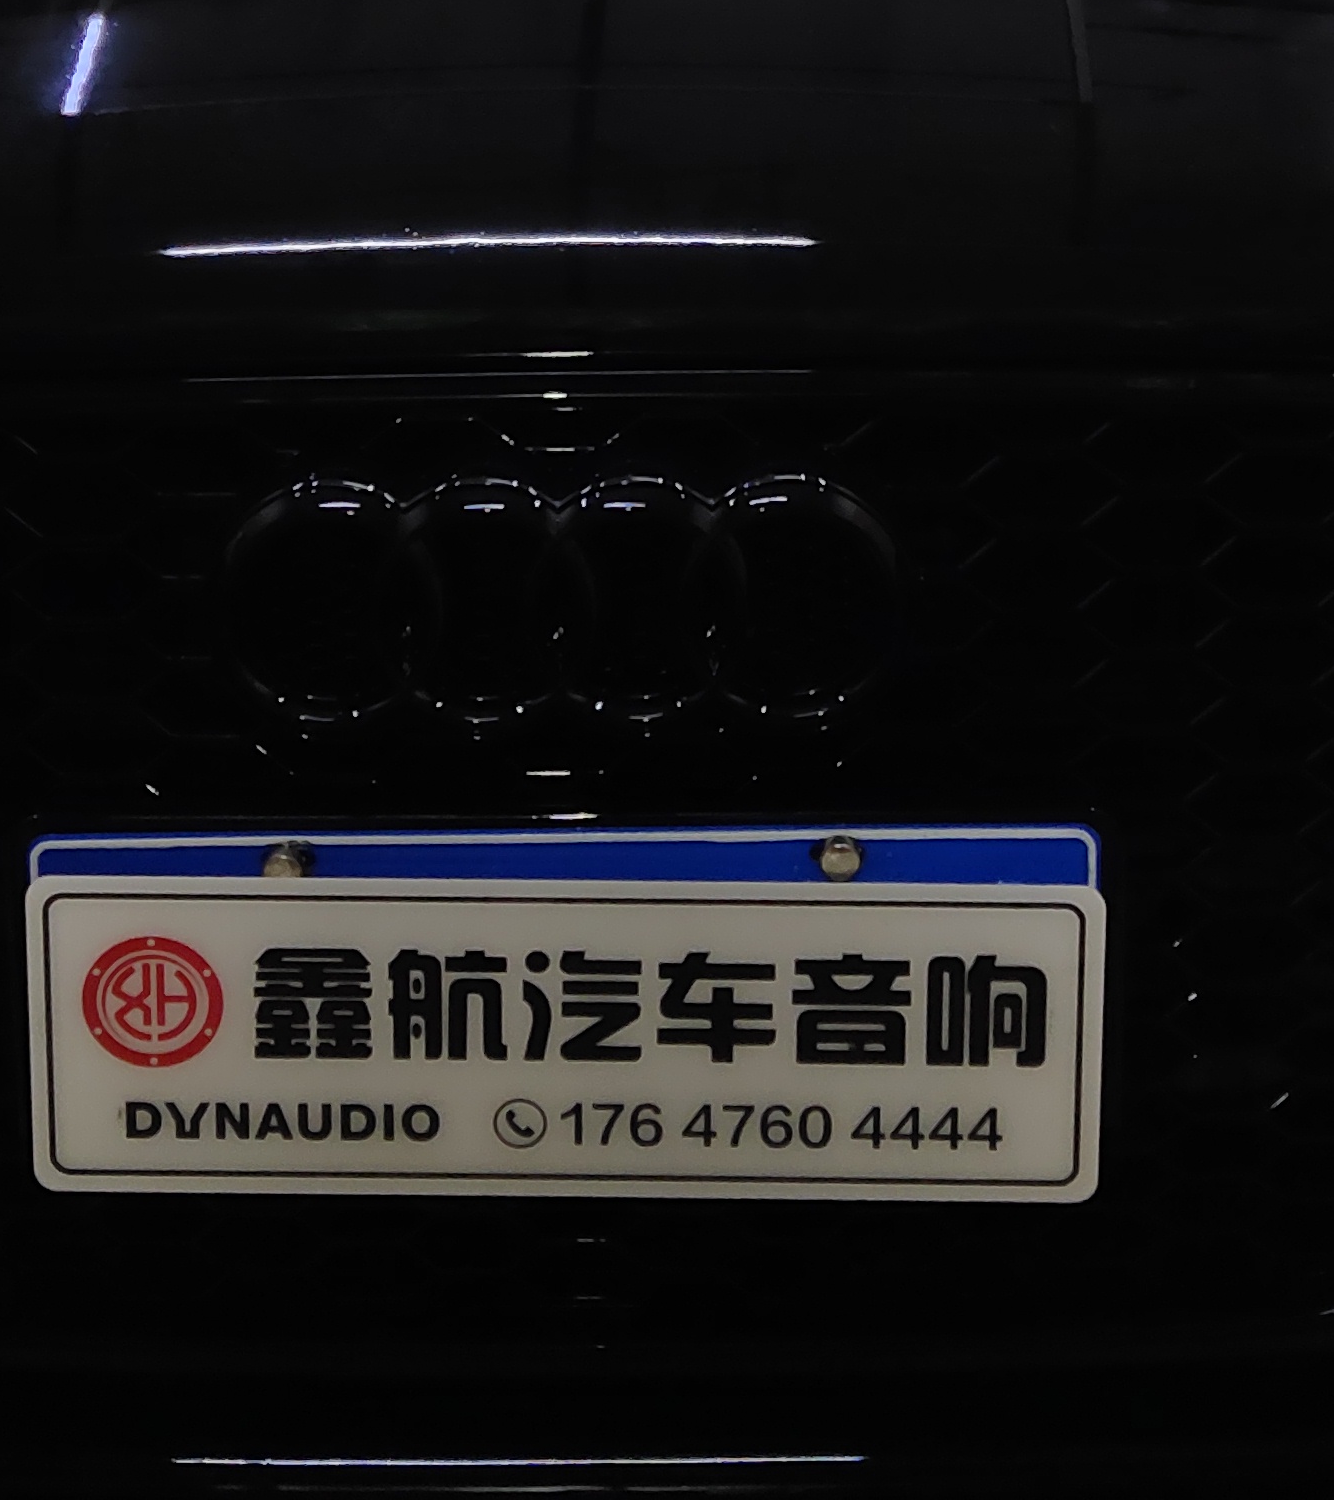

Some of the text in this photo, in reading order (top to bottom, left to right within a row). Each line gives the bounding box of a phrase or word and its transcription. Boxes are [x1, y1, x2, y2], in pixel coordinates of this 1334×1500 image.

[252, 947, 1049, 1068] 鑫航汽车音响
[124, 1100, 1004, 1151] DYNAUDIO 176 4760 4444
